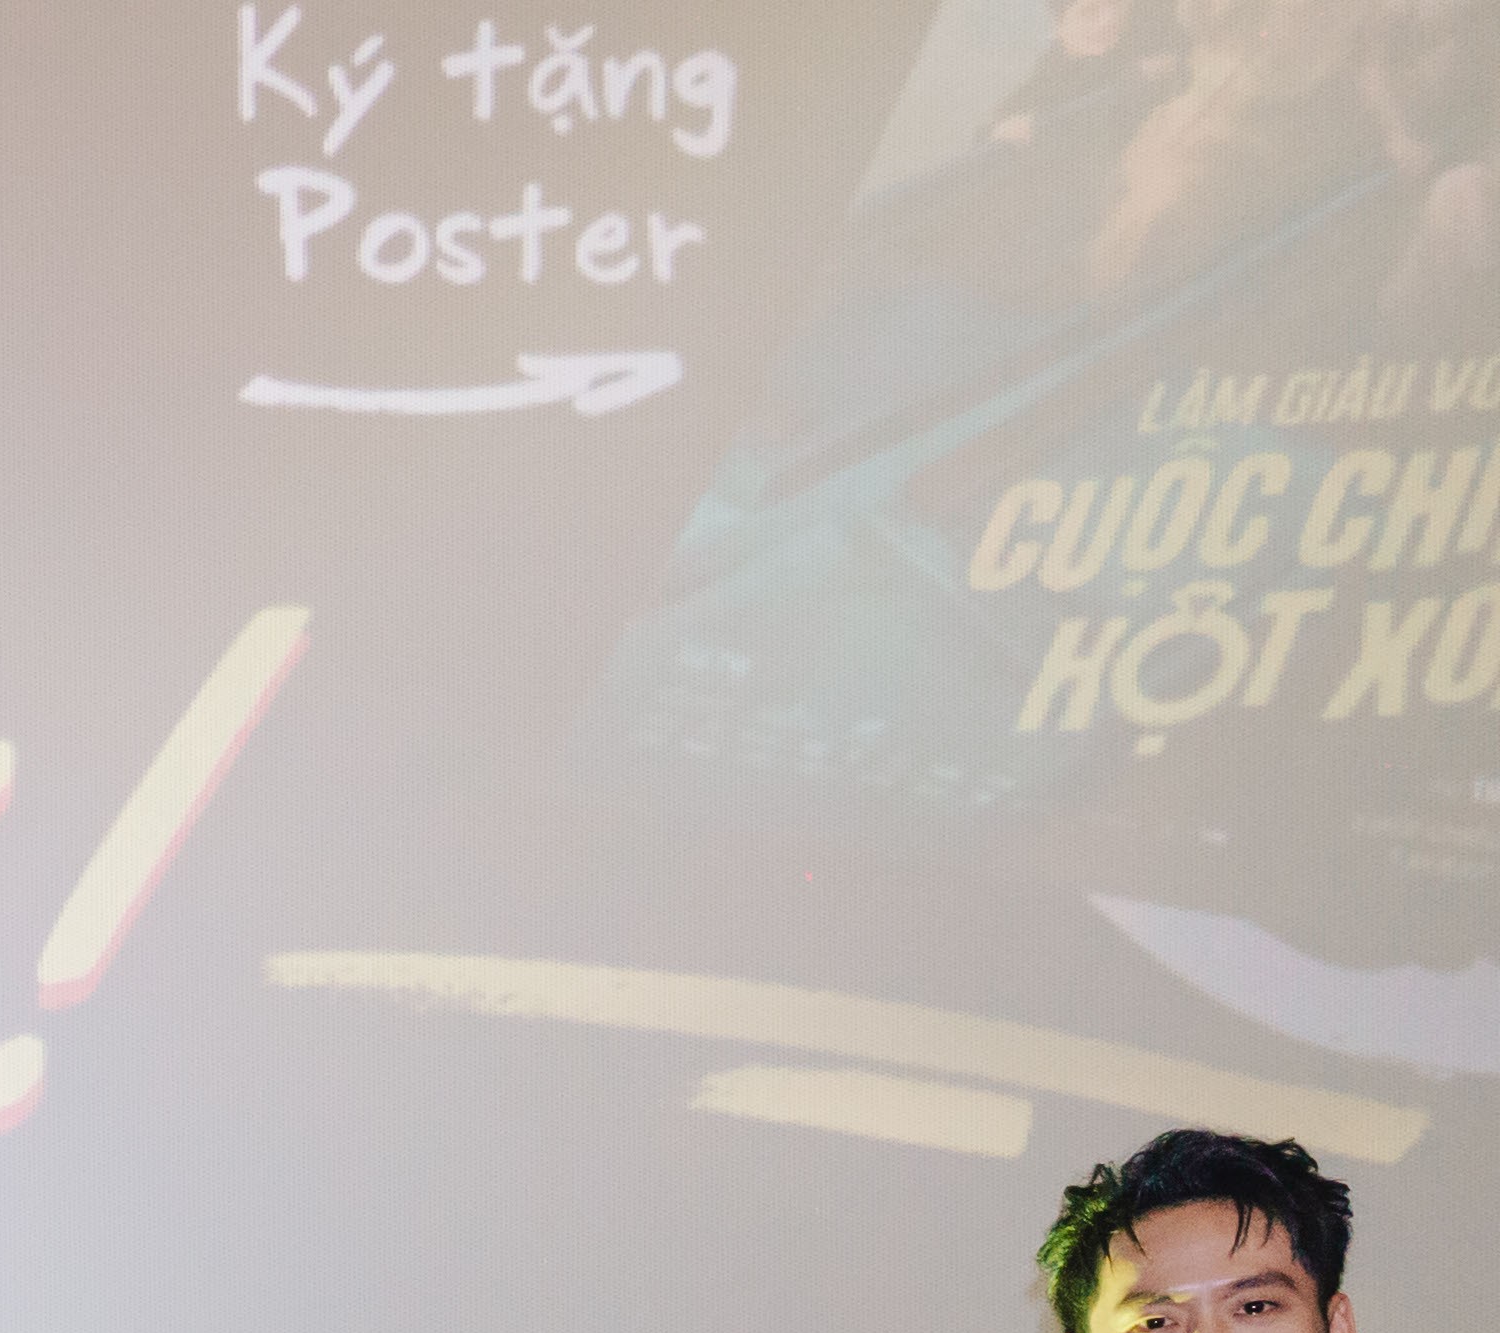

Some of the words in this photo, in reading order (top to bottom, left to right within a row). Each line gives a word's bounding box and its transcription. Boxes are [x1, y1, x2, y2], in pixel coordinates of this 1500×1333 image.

[238, 4, 395, 153] Ký
[441, 24, 738, 157] tặng
[255, 166, 704, 284] Poster
